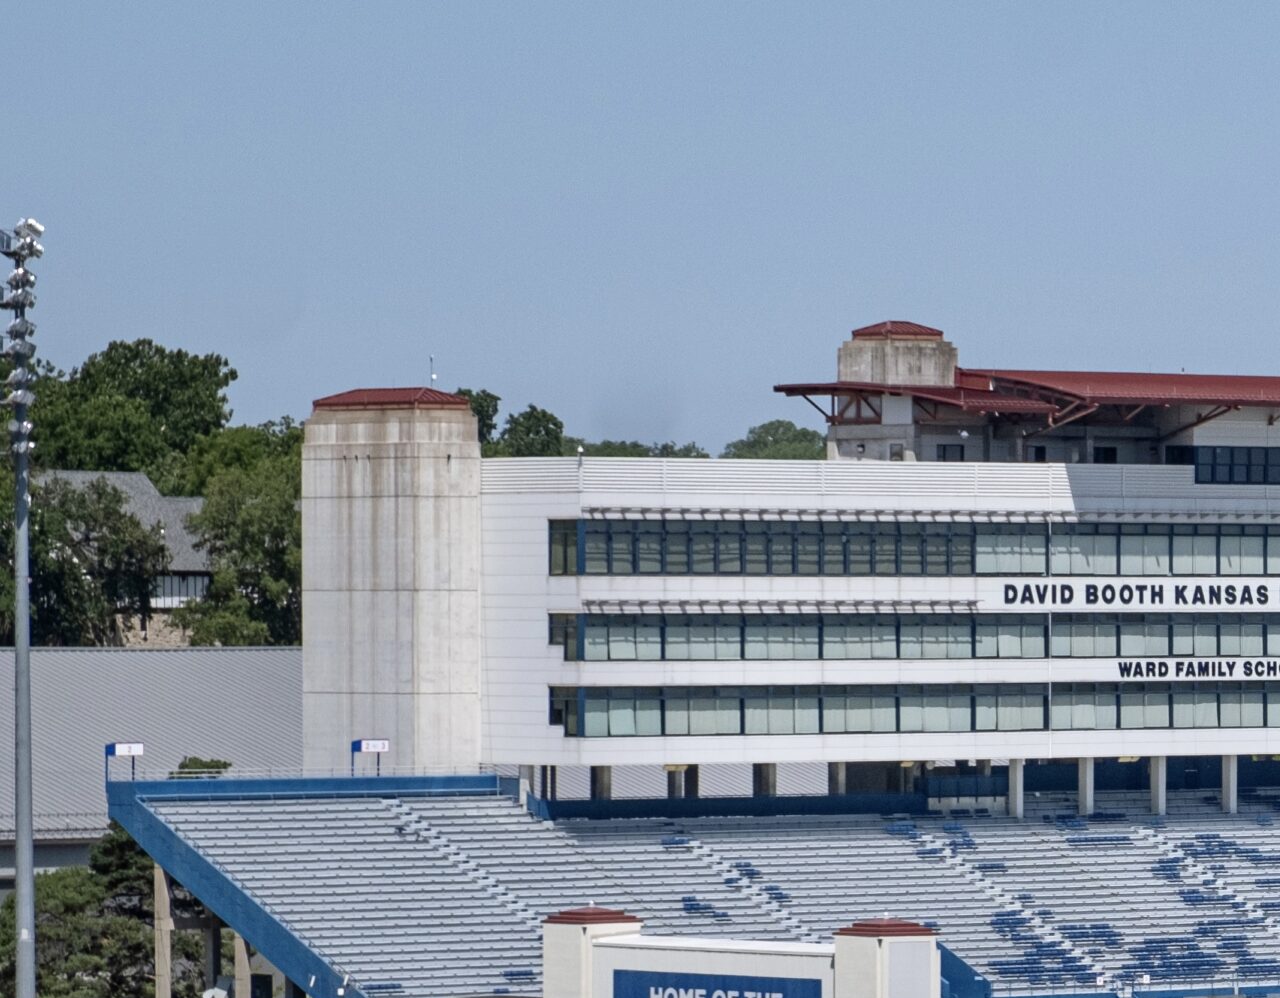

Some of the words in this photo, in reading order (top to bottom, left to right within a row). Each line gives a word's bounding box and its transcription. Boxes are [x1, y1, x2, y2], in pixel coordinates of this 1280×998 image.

[1003, 584, 1074, 605] DAVID
[1085, 584, 1164, 605] BOOTH
[1174, 584, 1269, 605] KANSAS
[1118, 661, 1169, 678] WARD
[1175, 661, 1237, 678] FAMILY
